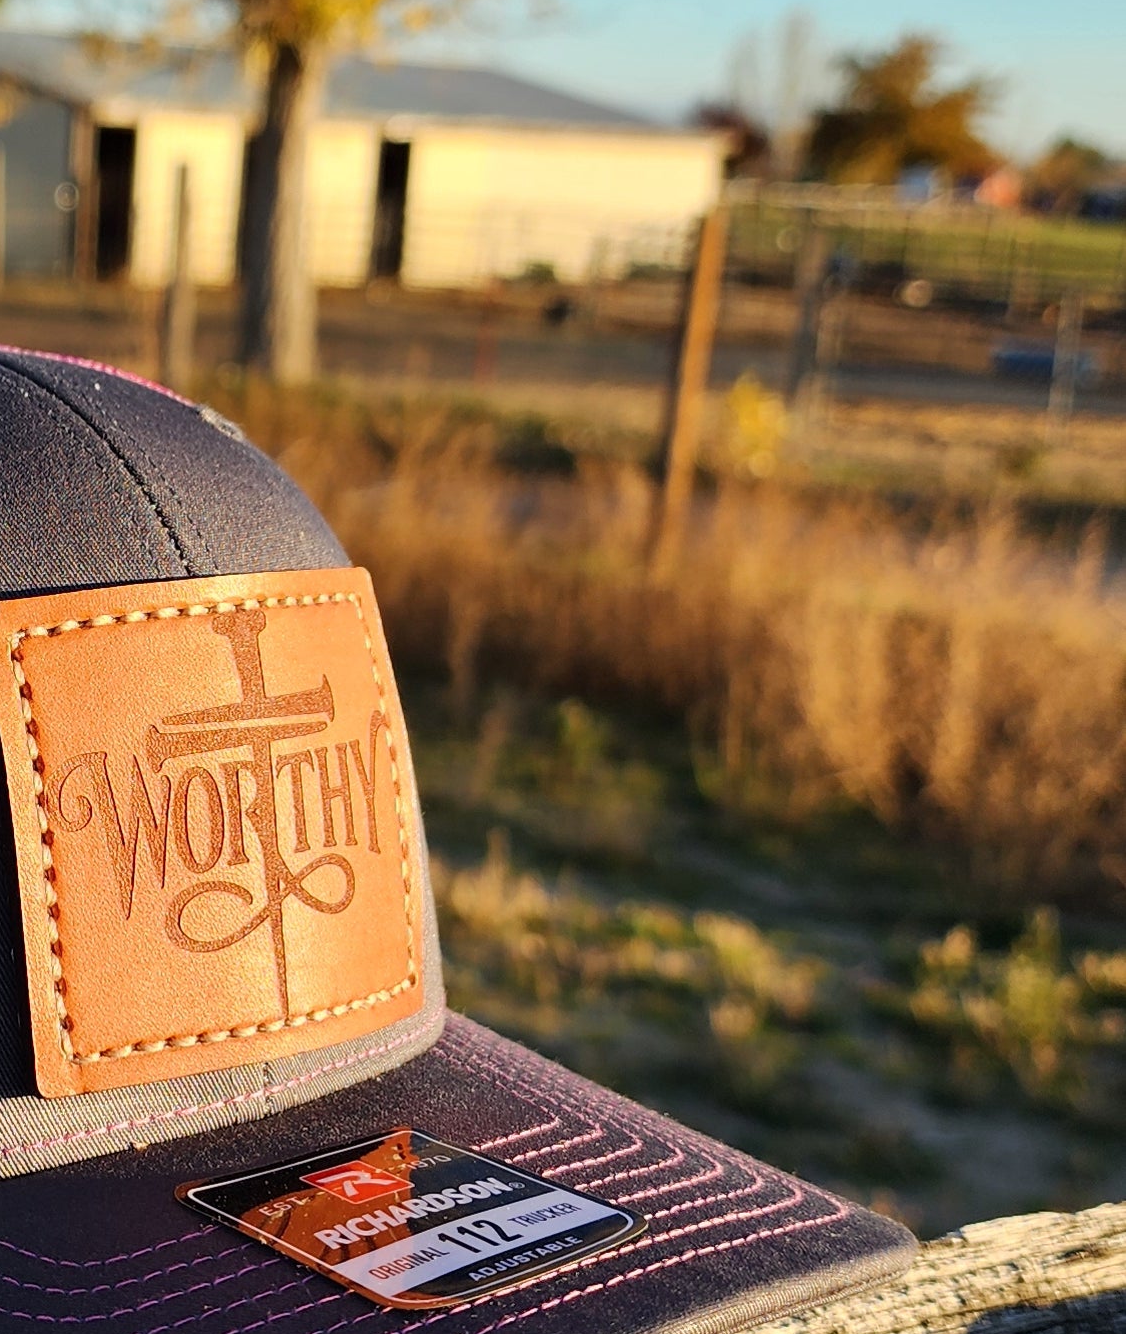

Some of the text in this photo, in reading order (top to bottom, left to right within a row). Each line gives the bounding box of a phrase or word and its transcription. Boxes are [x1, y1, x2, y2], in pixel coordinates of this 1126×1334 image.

[45, 710, 390, 921] WORTHY
[405, 1154, 452, 1170] 1970
[368, 1202, 582, 1280] ORIGINAL 112 TRUCKER
[468, 1235, 584, 1282] ADJUSTABLE
